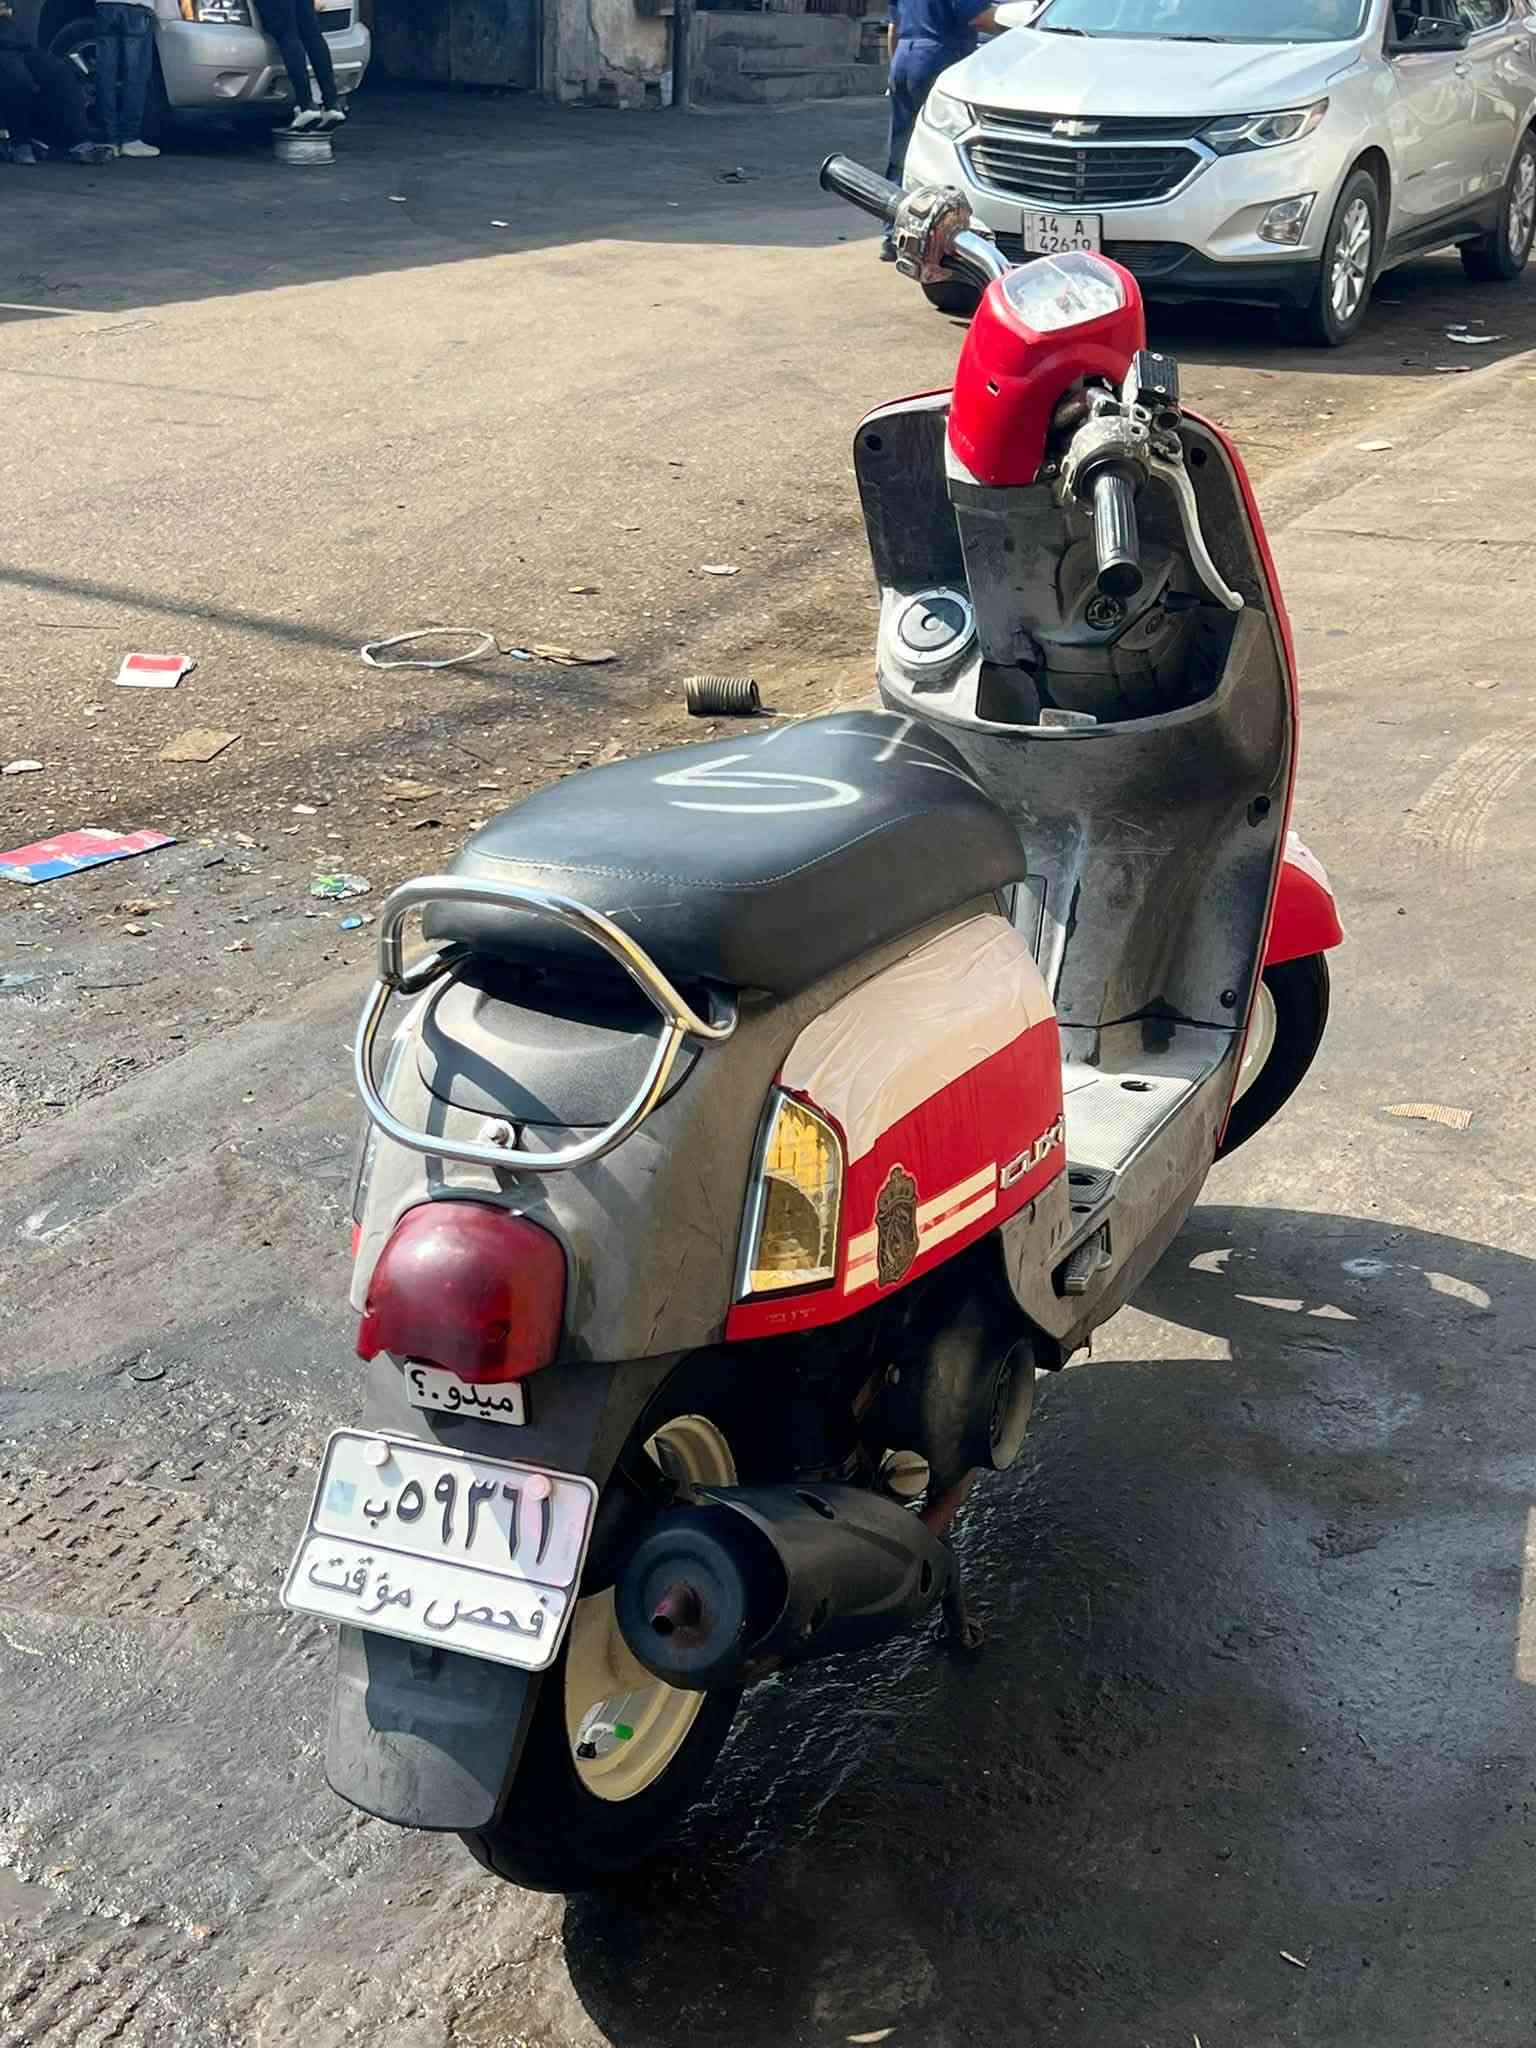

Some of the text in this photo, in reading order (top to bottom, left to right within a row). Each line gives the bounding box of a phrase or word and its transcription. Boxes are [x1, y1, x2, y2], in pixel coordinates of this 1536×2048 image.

[1039, 216, 1085, 235] 14 A
[308, 1555, 547, 1639] فحص مؤقت
